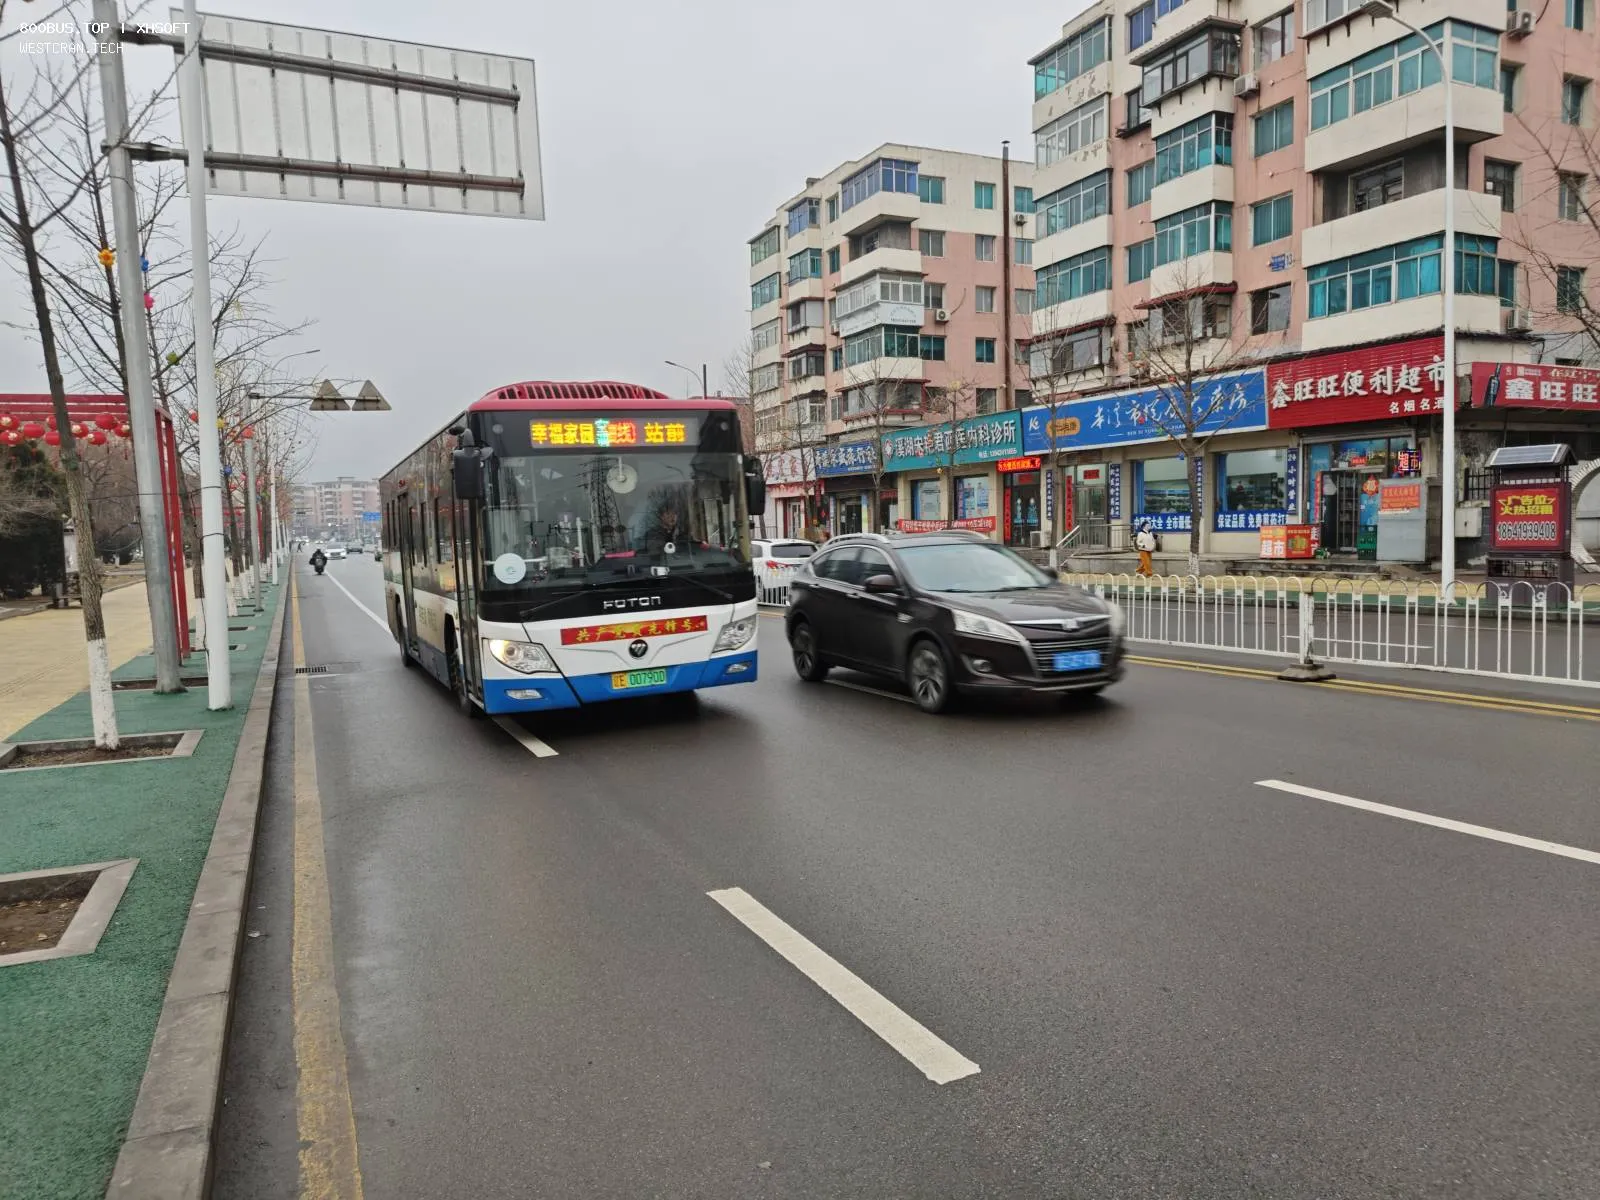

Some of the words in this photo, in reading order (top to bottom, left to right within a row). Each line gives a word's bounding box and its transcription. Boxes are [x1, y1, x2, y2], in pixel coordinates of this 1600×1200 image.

[1270, 355, 1444, 410] 鑫旺旺便利超市
[1505, 377, 1598, 403] 鑫旺旺
[531, 422, 595, 445] 幸福家园
[644, 421, 685, 444] 站前
[1217, 513, 1246, 529] 保证品质
[603, 596, 661, 610] FOTON
